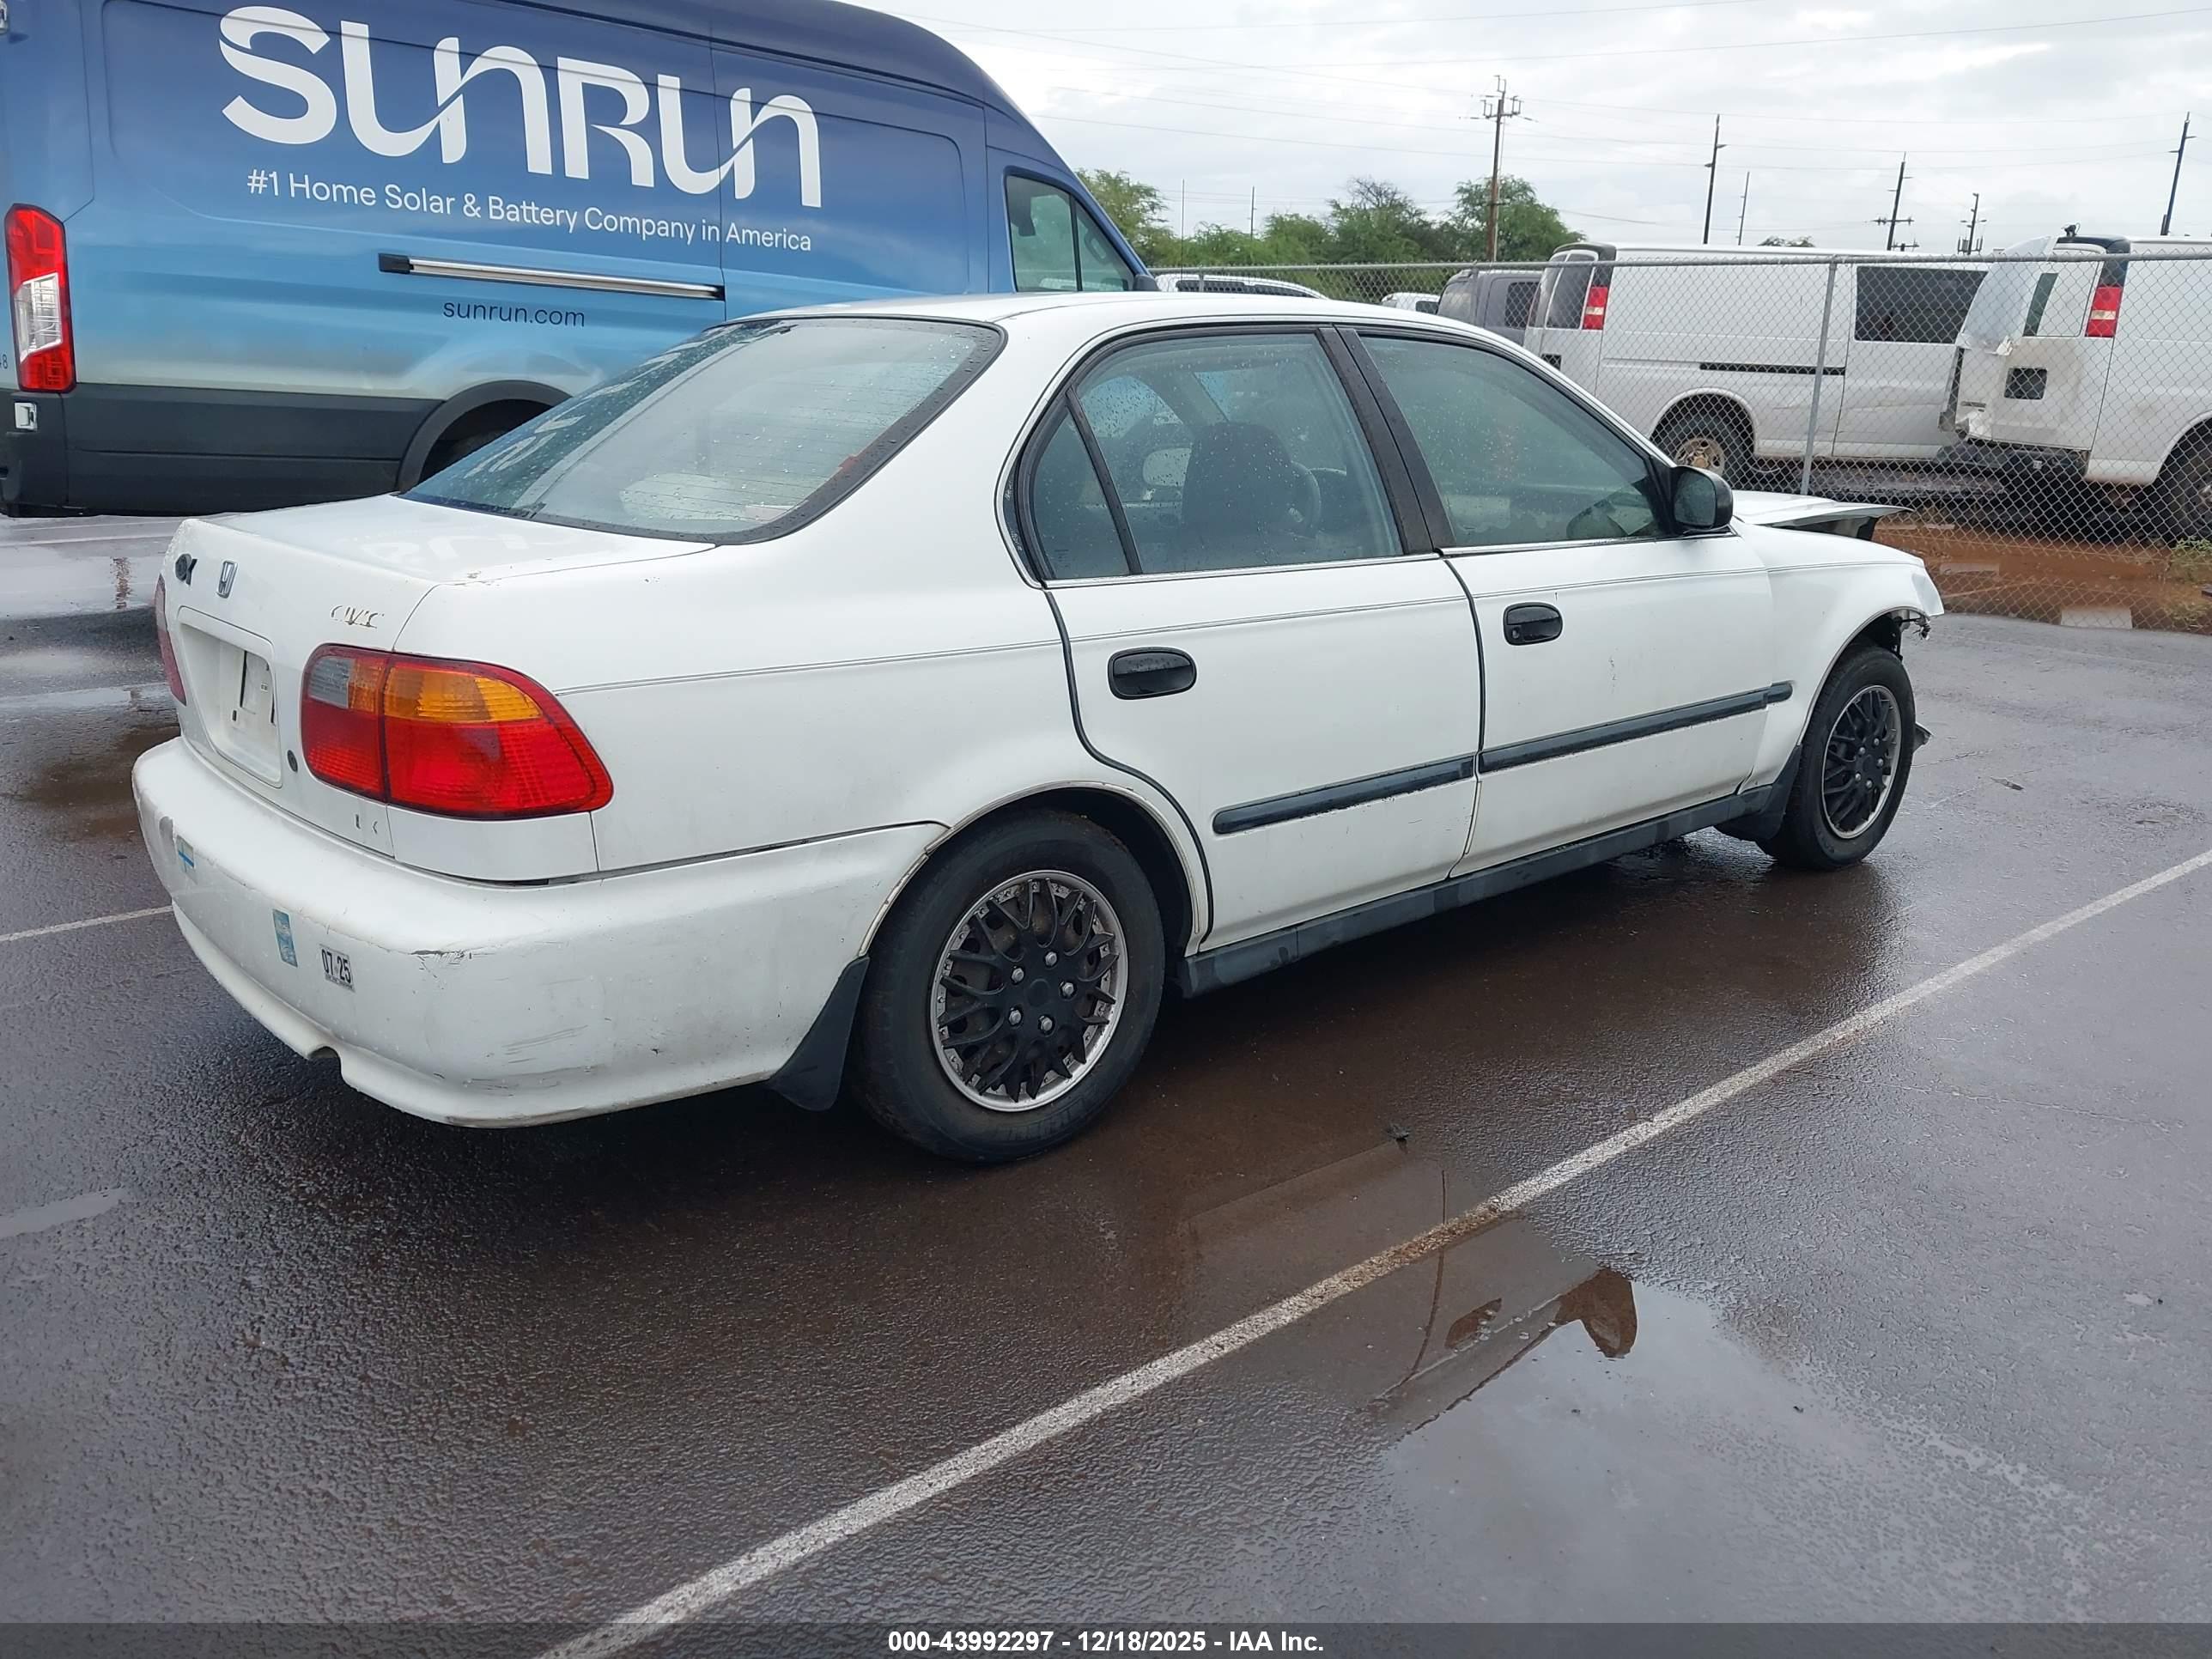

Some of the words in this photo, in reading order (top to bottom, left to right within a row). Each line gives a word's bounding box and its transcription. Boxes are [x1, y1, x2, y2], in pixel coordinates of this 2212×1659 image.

[246, 169, 279, 197] #1
[289, 173, 376, 206] Home
[385, 185, 455, 215] Solar
[463, 193, 482, 219] &
[488, 196, 578, 234] Battery
[584, 208, 696, 246] Company
[702, 219, 720, 242] in
[725, 222, 811, 252] America
[443, 302, 585, 327] sunrun.com
